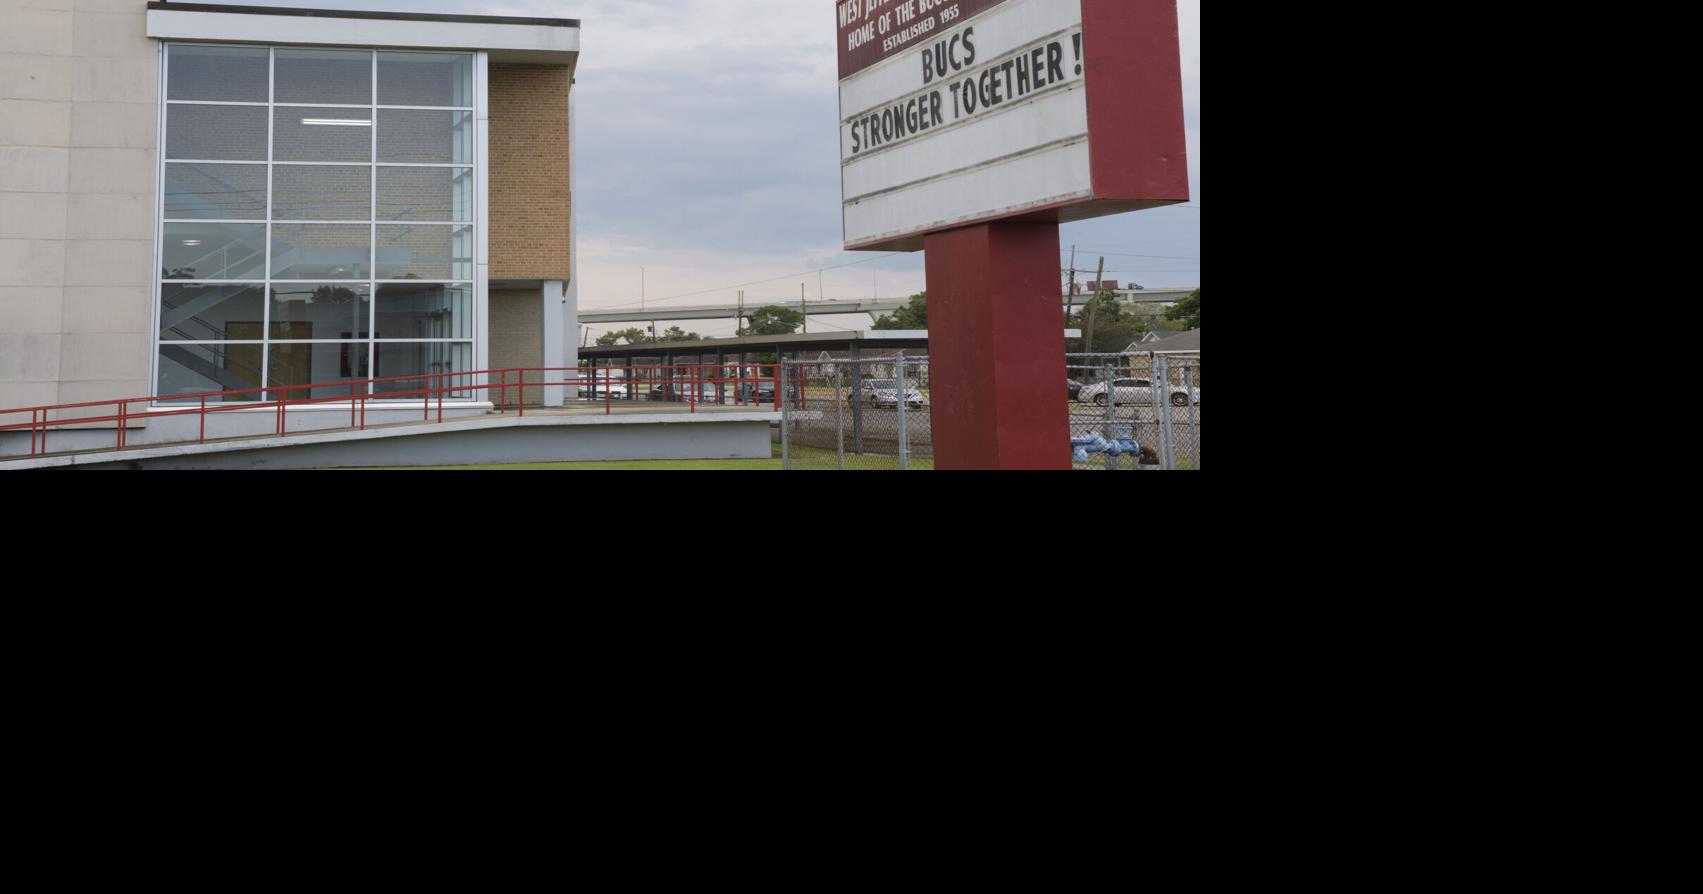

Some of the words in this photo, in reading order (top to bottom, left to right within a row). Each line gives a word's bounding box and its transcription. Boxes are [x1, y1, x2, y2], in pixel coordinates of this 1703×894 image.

[848, 21, 875, 51] HOME
[878, 12, 893, 35] OF
[895, 0, 915, 26] THE
[883, 16, 935, 52] ESTABLISHED
[940, 4, 960, 24] 1955
[922, 26, 975, 84] BUCS
[851, 90, 943, 153] STRONGER
[949, 41, 1065, 119] TOGETHER
